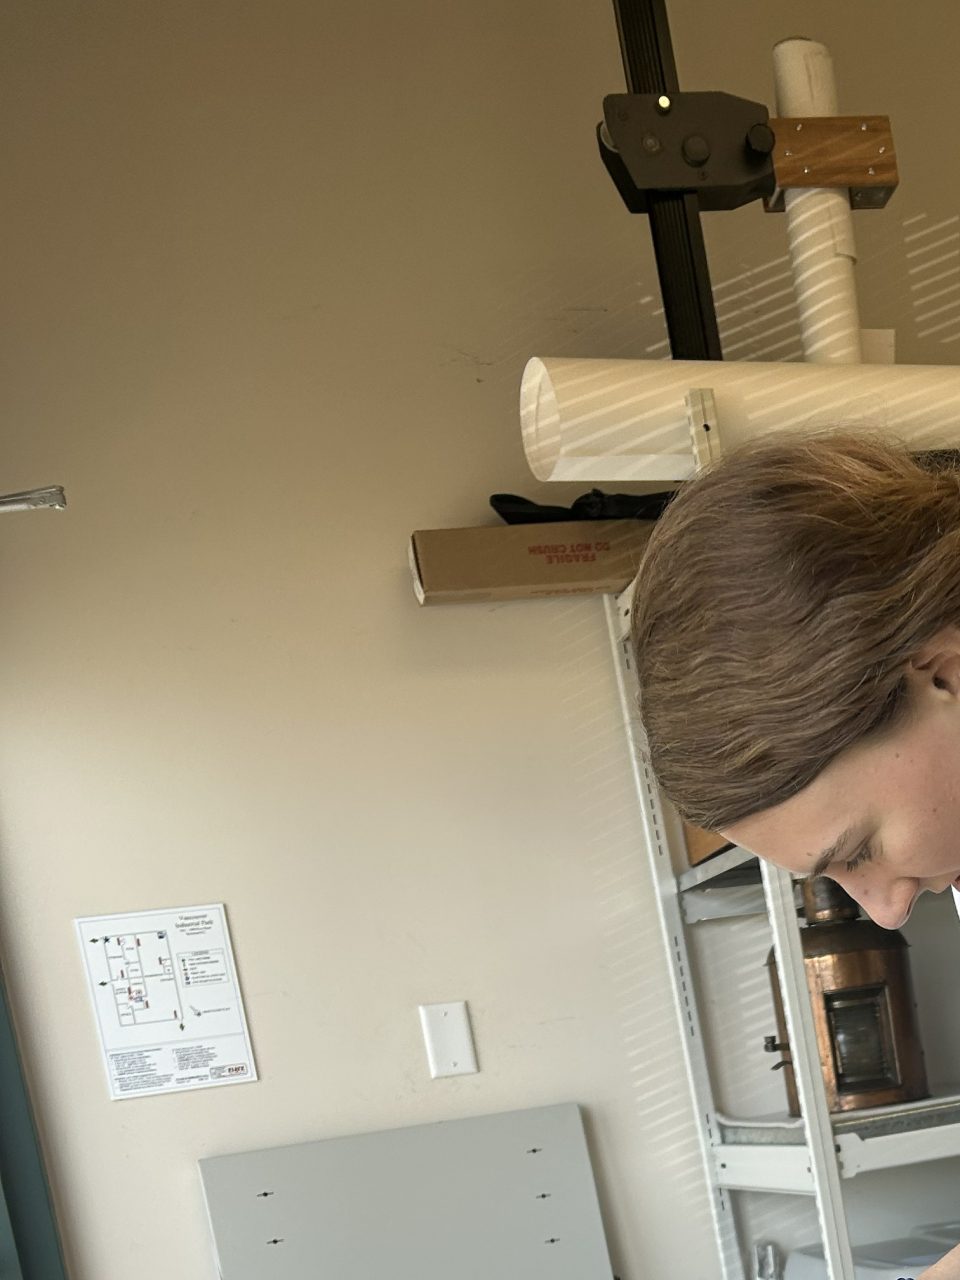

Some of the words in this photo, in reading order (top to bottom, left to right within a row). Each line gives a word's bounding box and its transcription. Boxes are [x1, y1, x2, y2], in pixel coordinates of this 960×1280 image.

[528, 544, 566, 555] CRUSH
[570, 543, 592, 553] NOT
[546, 554, 596, 564] FRAGILE
